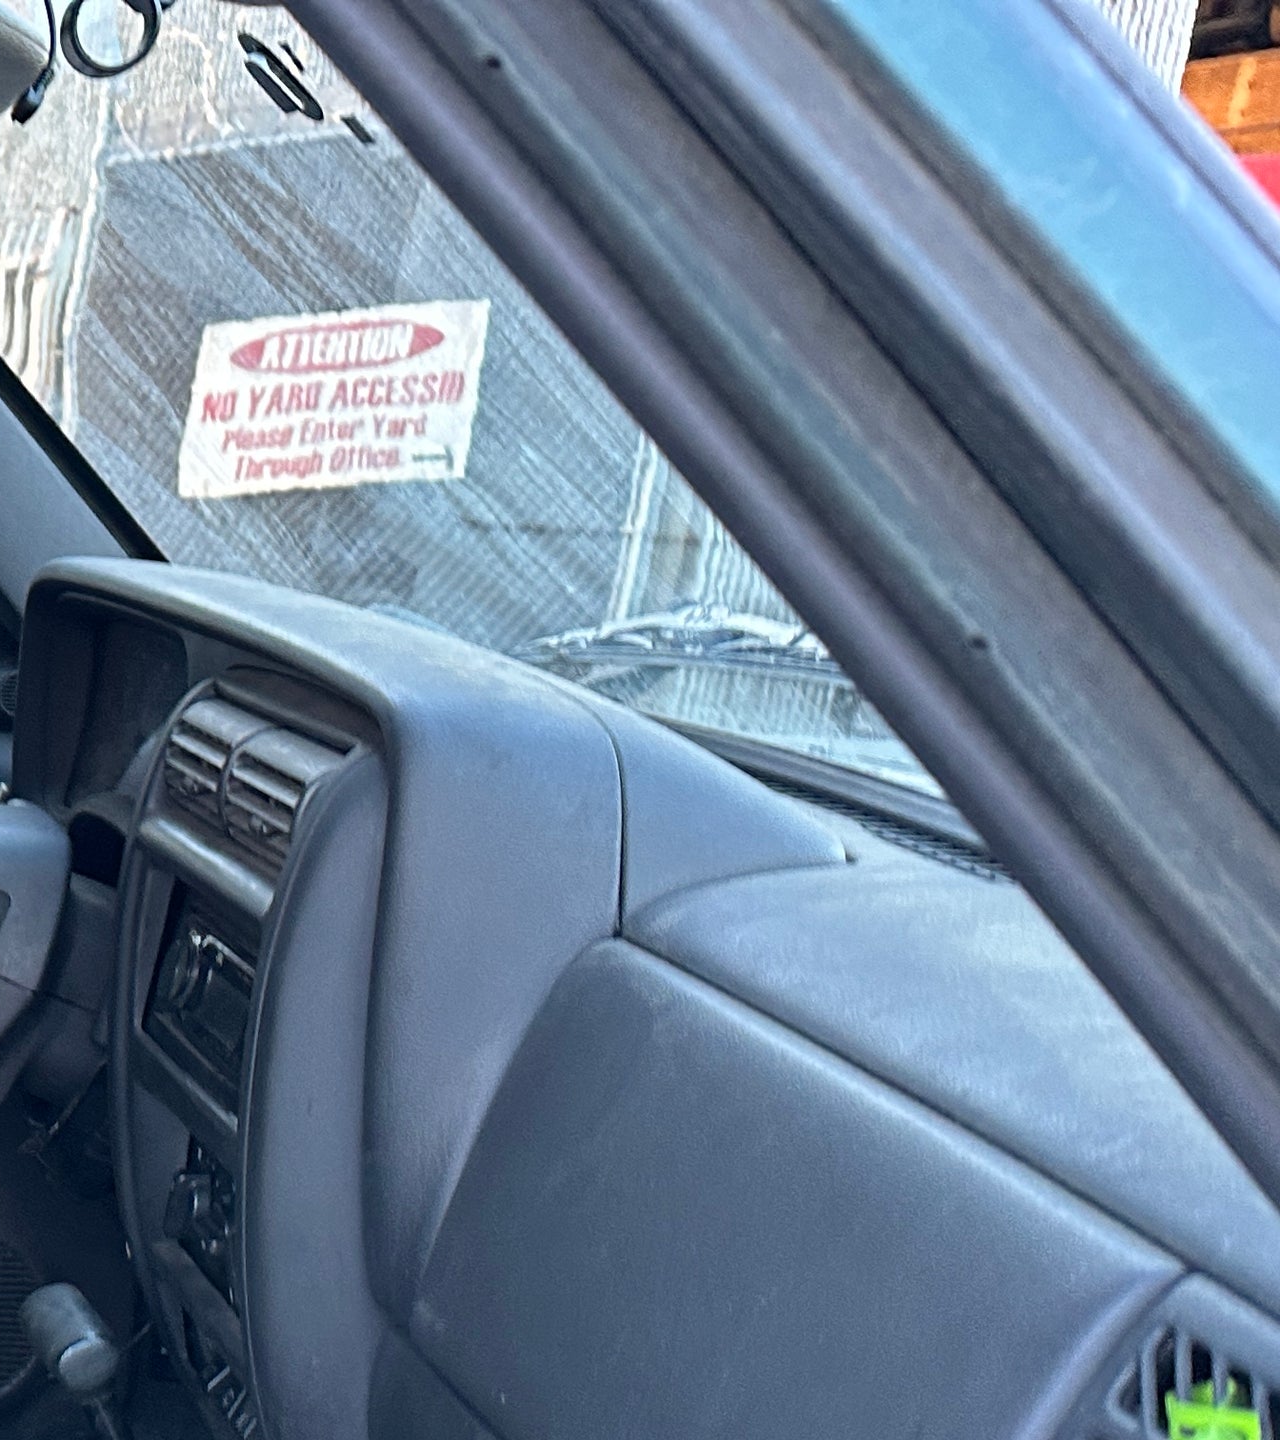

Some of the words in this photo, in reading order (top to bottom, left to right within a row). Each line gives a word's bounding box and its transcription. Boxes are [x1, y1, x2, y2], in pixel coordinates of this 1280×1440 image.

[260, 322, 415, 369] ATTENTION
[200, 390, 238, 424] NO
[248, 379, 324, 420] YARD
[328, 370, 466, 412] ACCESS!!!
[221, 423, 294, 453] Please
[299, 416, 364, 447] Enter
[372, 412, 429, 440] Yard
[234, 448, 322, 482] Through
[328, 445, 402, 474] Office
